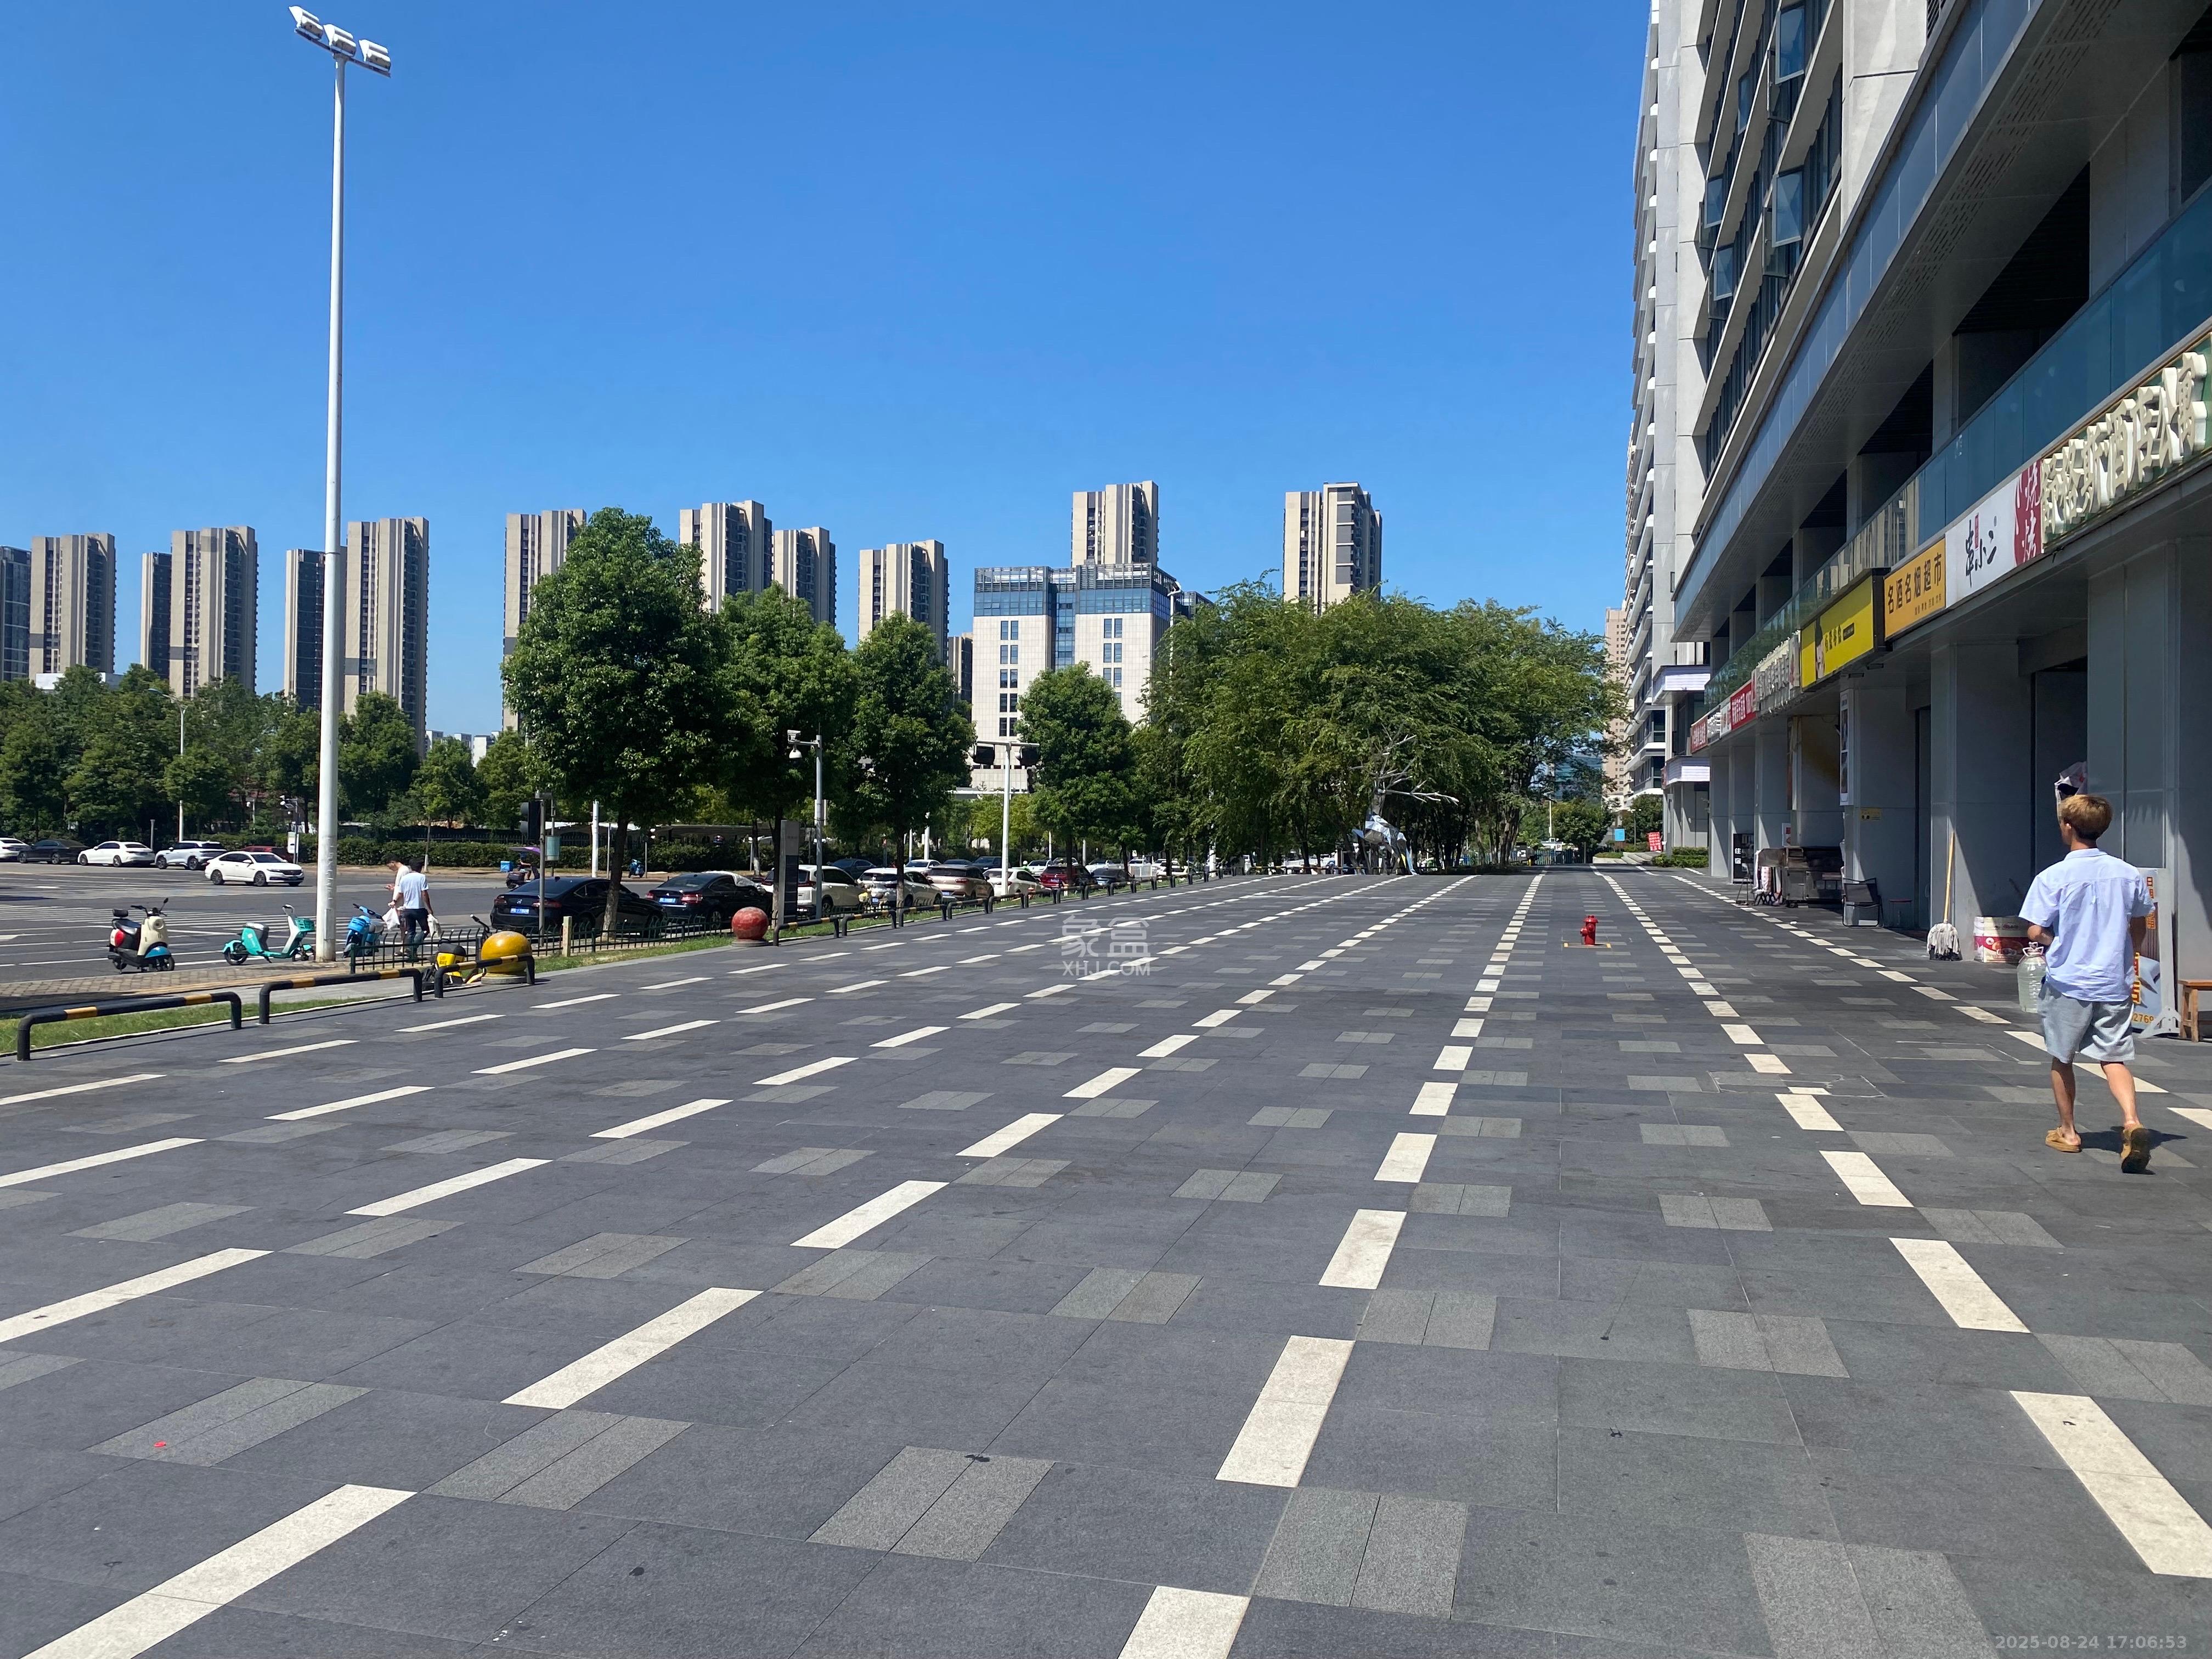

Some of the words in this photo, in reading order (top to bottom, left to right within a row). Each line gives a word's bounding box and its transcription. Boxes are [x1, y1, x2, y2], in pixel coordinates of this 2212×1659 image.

[2022, 461, 2041, 563] 烧烤
[1888, 552, 1942, 614] 名酒名烟超市
